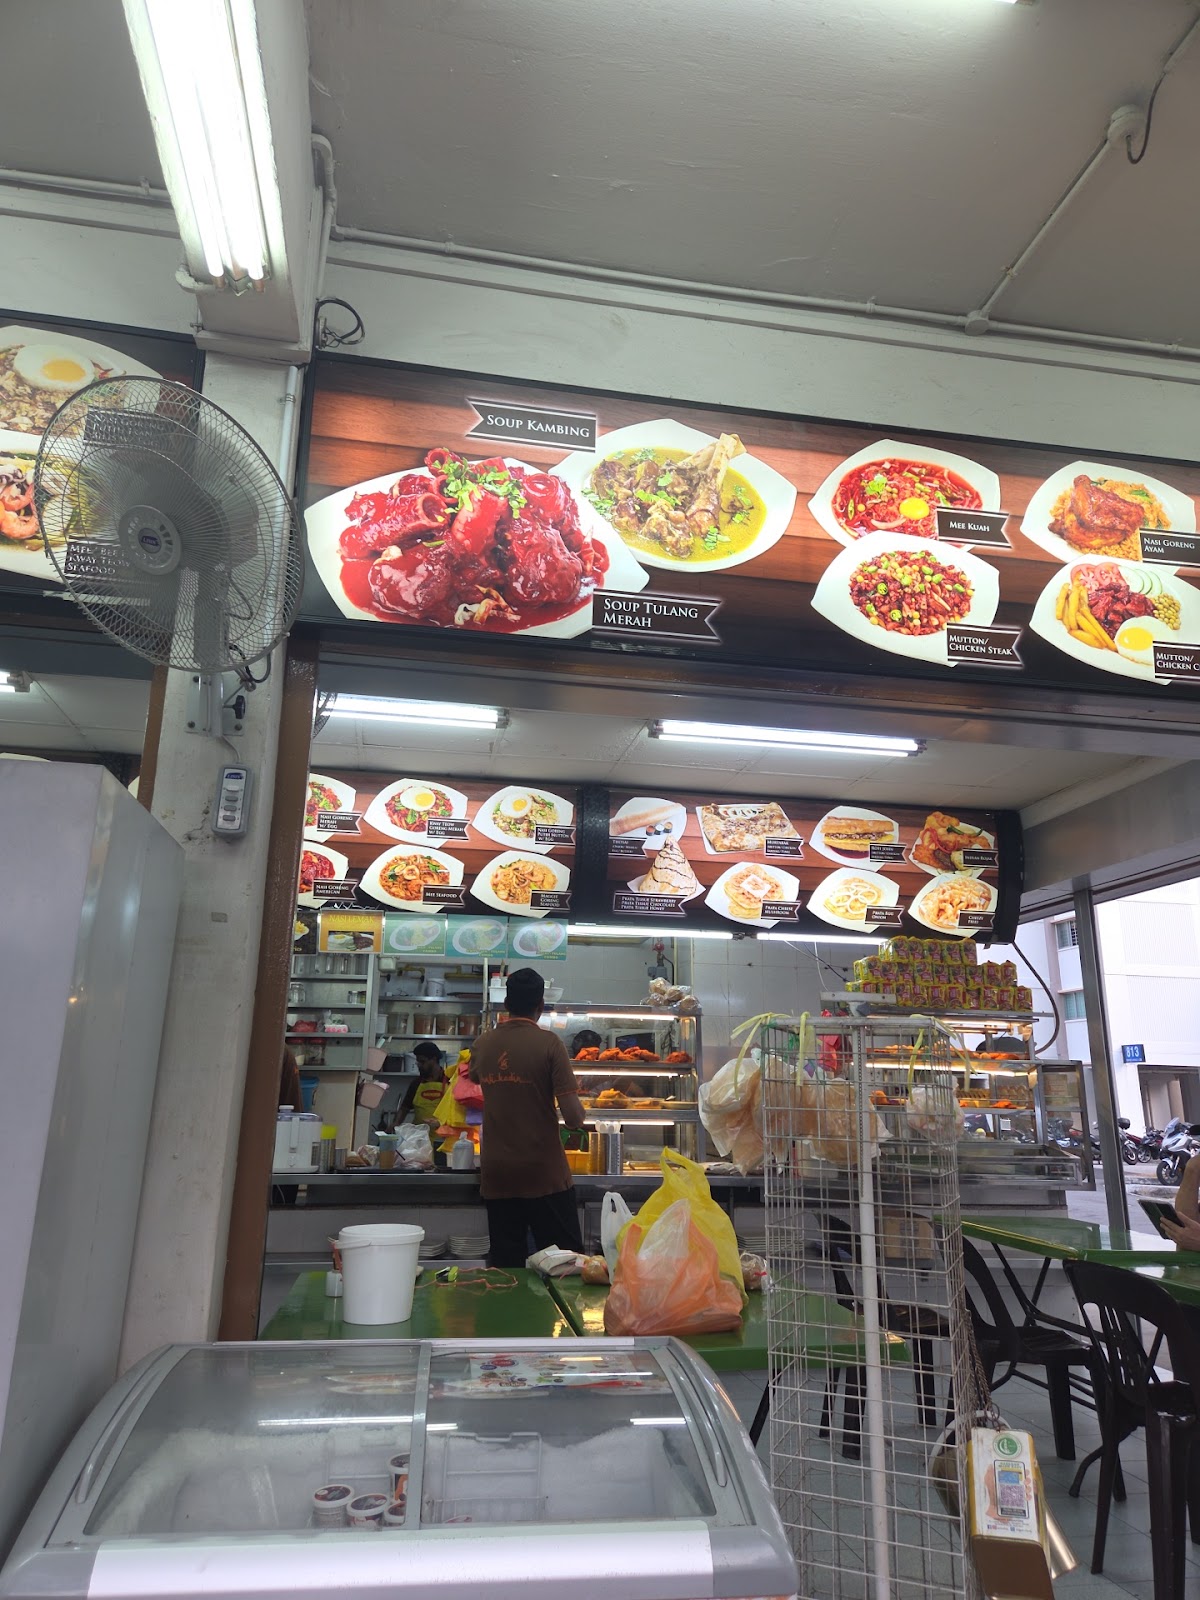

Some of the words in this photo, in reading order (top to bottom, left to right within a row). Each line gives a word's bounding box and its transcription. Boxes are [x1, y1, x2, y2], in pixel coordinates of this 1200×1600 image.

[486, 414, 523, 429] SOUP
[527, 420, 590, 438] KAMBING
[949, 521, 966, 530] MEE
[968, 523, 990, 532] KUAH
[1143, 537, 1161, 545] NASI
[1163, 540, 1195, 549] GORENG
[1144, 545, 1165, 554] AYAM
[603, 598, 640, 613] SOUP
[643, 602, 699, 619] TULANG
[603, 612, 652, 628] MERAH
[949, 635, 989, 645] MUTTON/
[949, 643, 986, 654] CHICKEN
[988, 646, 1013, 656] STEAK
[1156, 652, 1194, 662] MUTTON/
[1156, 660, 1192, 670] CHICKEN
